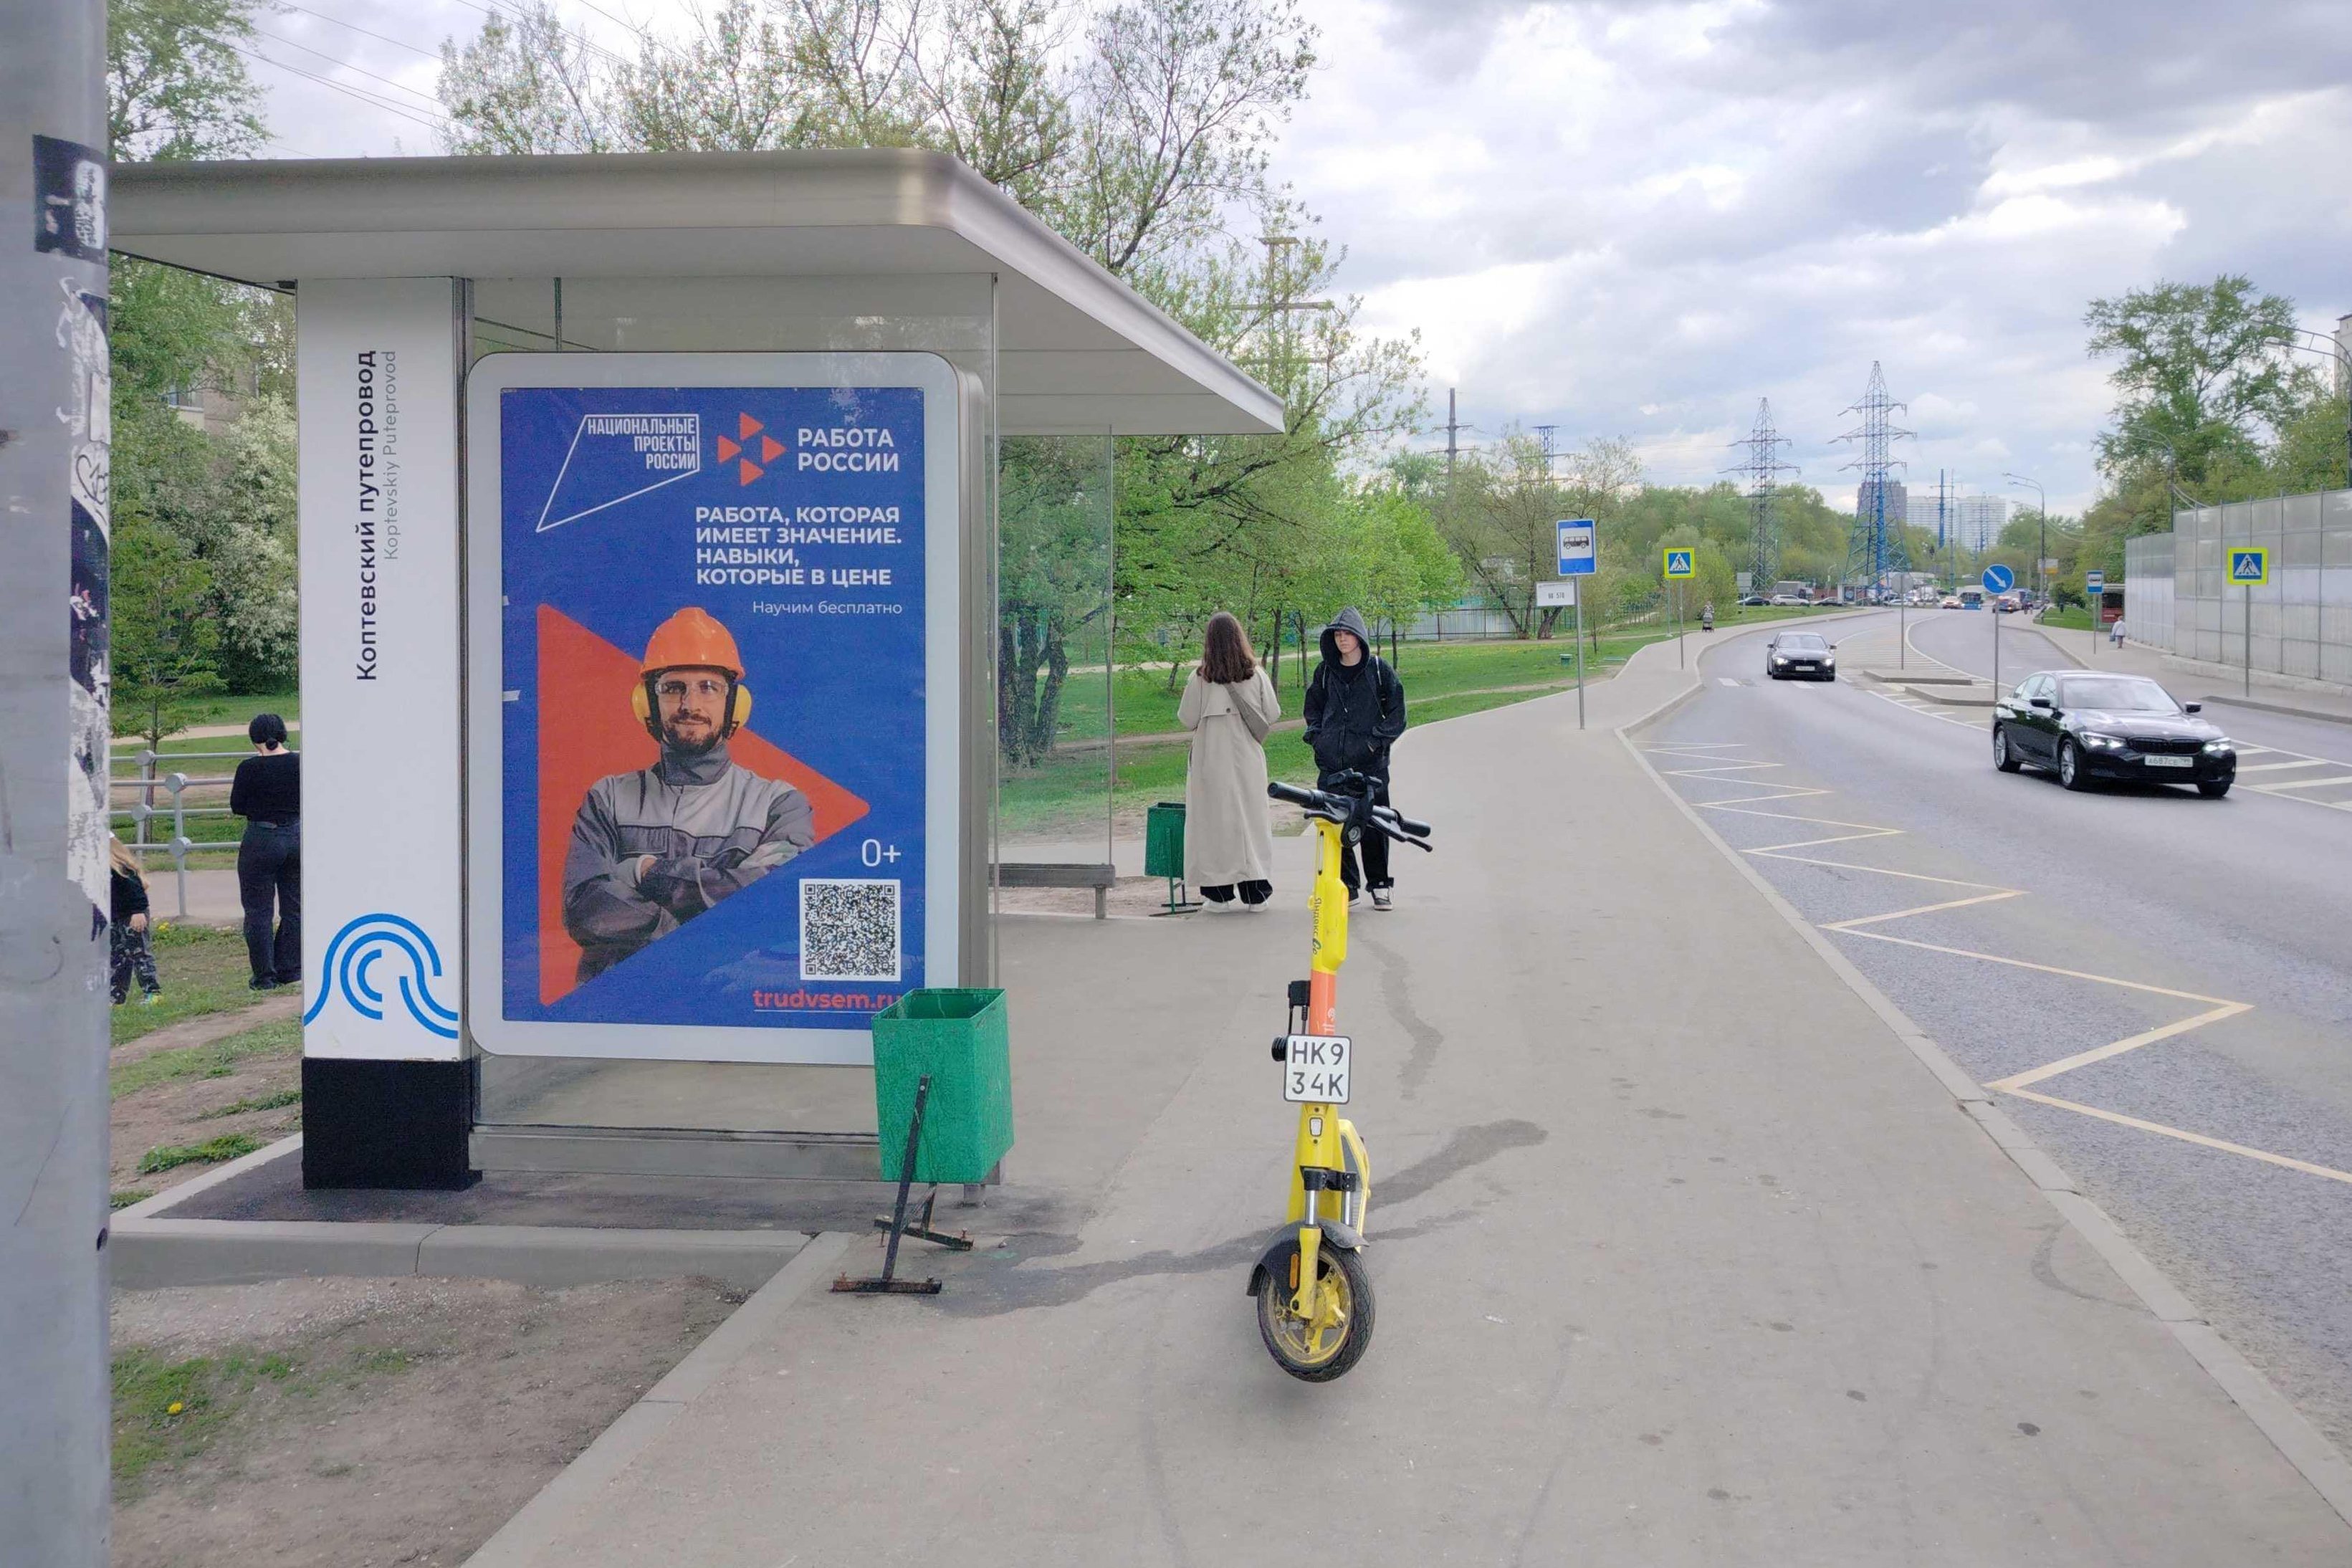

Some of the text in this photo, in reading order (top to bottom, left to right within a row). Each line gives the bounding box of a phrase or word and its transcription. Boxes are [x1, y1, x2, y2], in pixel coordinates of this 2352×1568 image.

[587, 417, 696, 435] НАЦИОНАЛЬНЫЕ
[634, 435, 696, 452] ПРОЕКТЫ
[798, 428, 894, 447] РАБОТА
[381, 350, 401, 560] Koptevskiy Puteprovod
[646, 453, 697, 470] РОССИИ
[798, 452, 899, 472] РОССИИ
[355, 350, 379, 680] Коптевский путепровод
[696, 507, 899, 525] РАБОТА, КОТОРАЯ
[696, 527, 902, 544] ИМЕЕТ ЗНАЧЕНИЕ.
[696, 548, 800, 568] НАВЫКИ,
[696, 568, 891, 588] КОТОРЫЕ В ЦЕНЕ
[752, 600, 903, 616] Научим бесплатно
[861, 838, 902, 867] 0+
